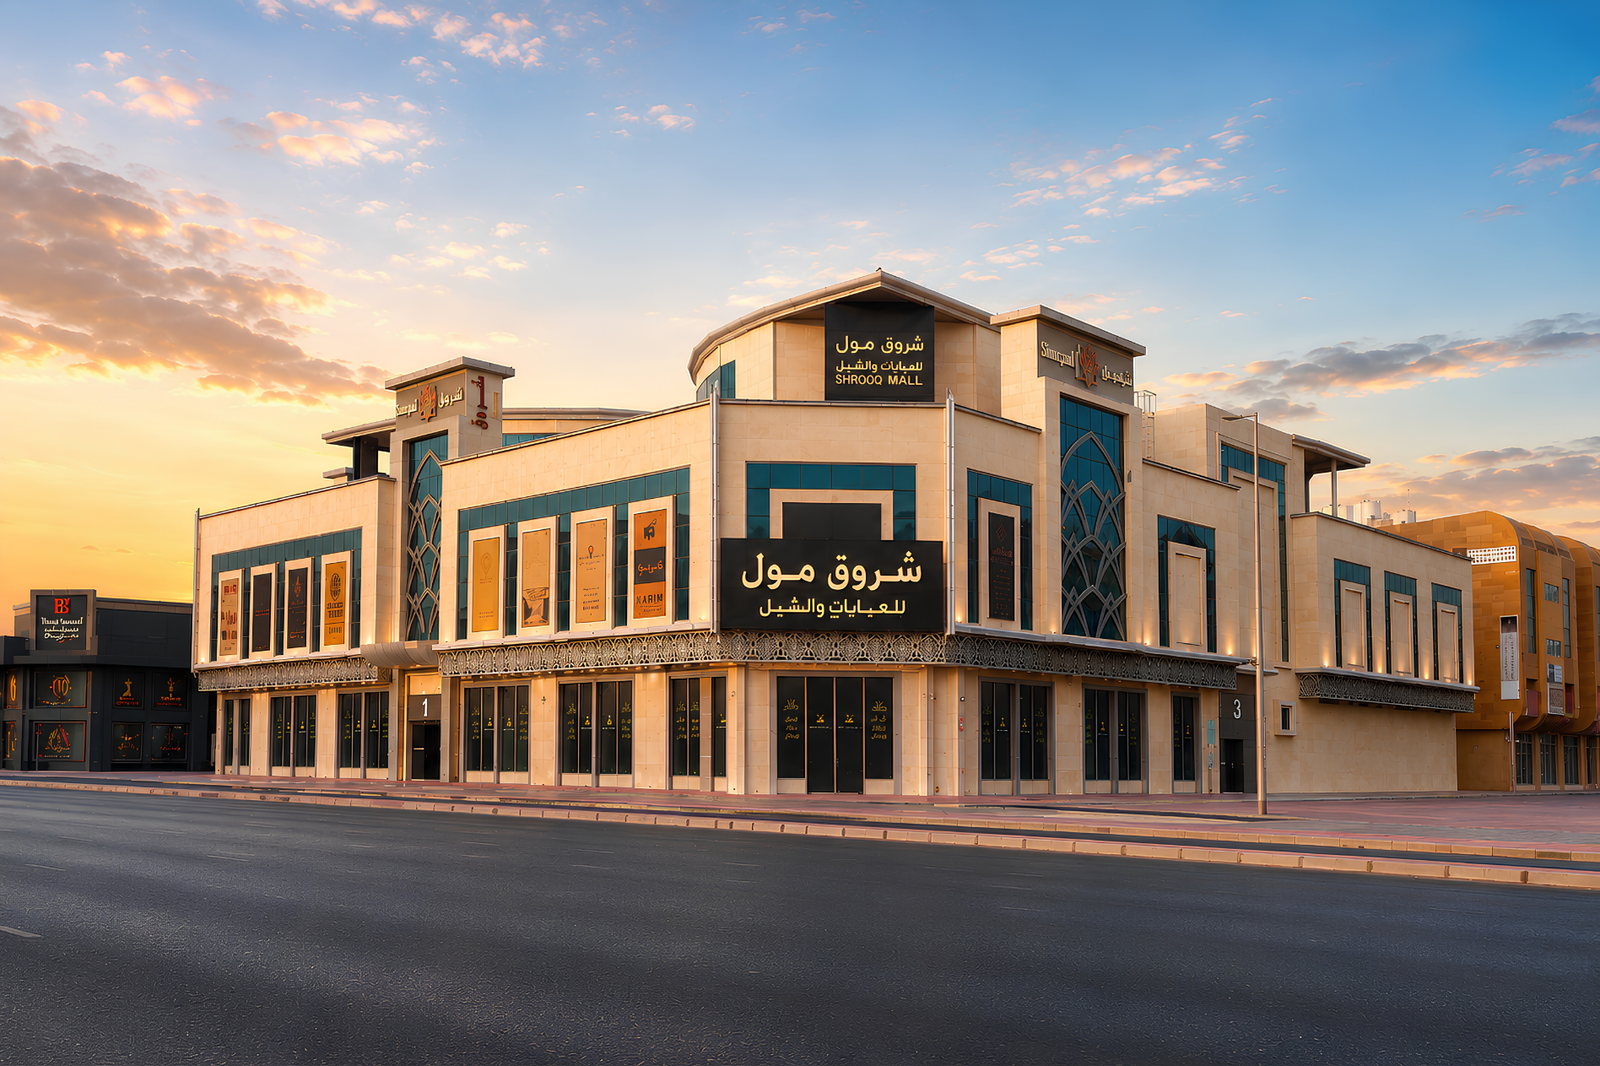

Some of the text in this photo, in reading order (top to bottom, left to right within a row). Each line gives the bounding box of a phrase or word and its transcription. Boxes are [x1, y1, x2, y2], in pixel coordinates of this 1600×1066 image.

[835, 335, 924, 355] شروق مول
[835, 358, 878, 373] والشيل
[835, 374, 923, 386] SHROOQ MALL
[741, 550, 922, 591] شروق مول
[759, 596, 825, 618] والشيل
[422, 697, 428, 717] 1
[1233, 699, 1241, 719] 3
